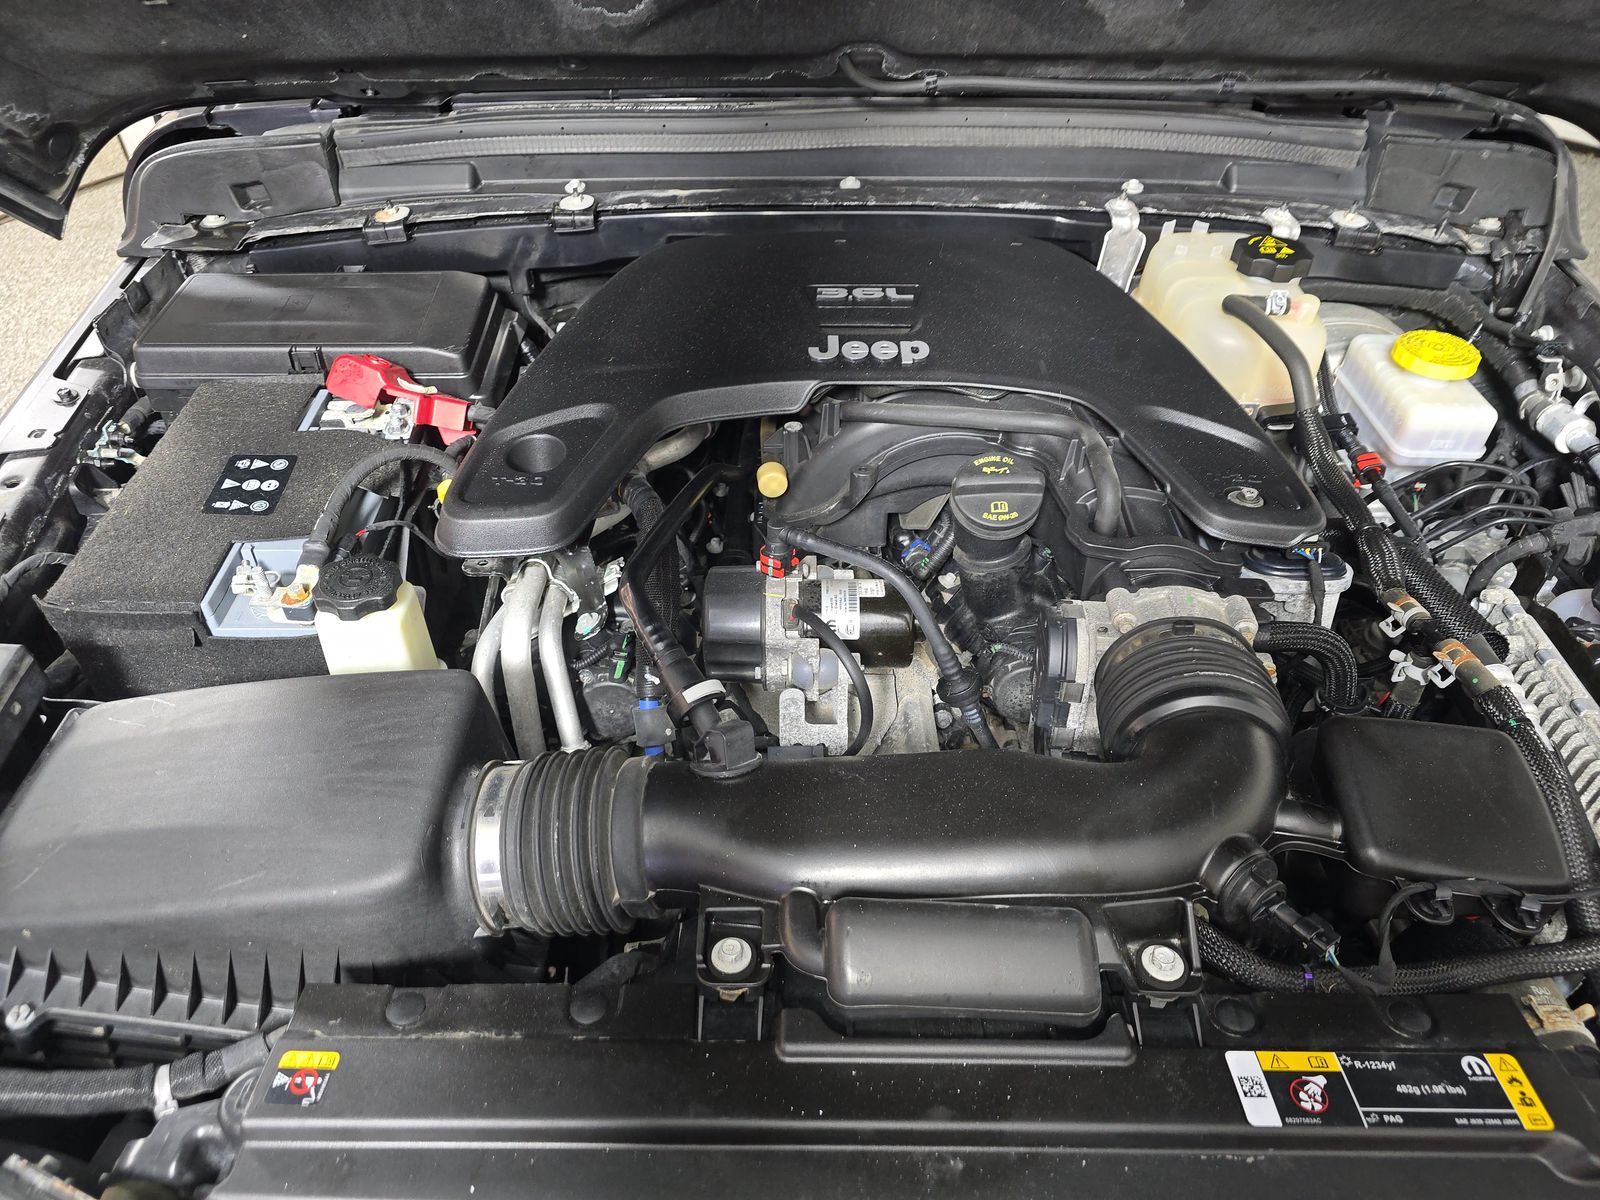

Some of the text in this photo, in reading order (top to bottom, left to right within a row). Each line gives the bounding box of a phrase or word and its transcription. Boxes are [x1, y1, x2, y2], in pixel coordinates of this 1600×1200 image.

[815, 287, 915, 303] 3.6L
[807, 334, 930, 365] Jeep
[973, 455, 1015, 466] ENGINE OIL
[982, 511, 1019, 521] SAE 0W-20
[1383, 1114, 1404, 1124] PAG
